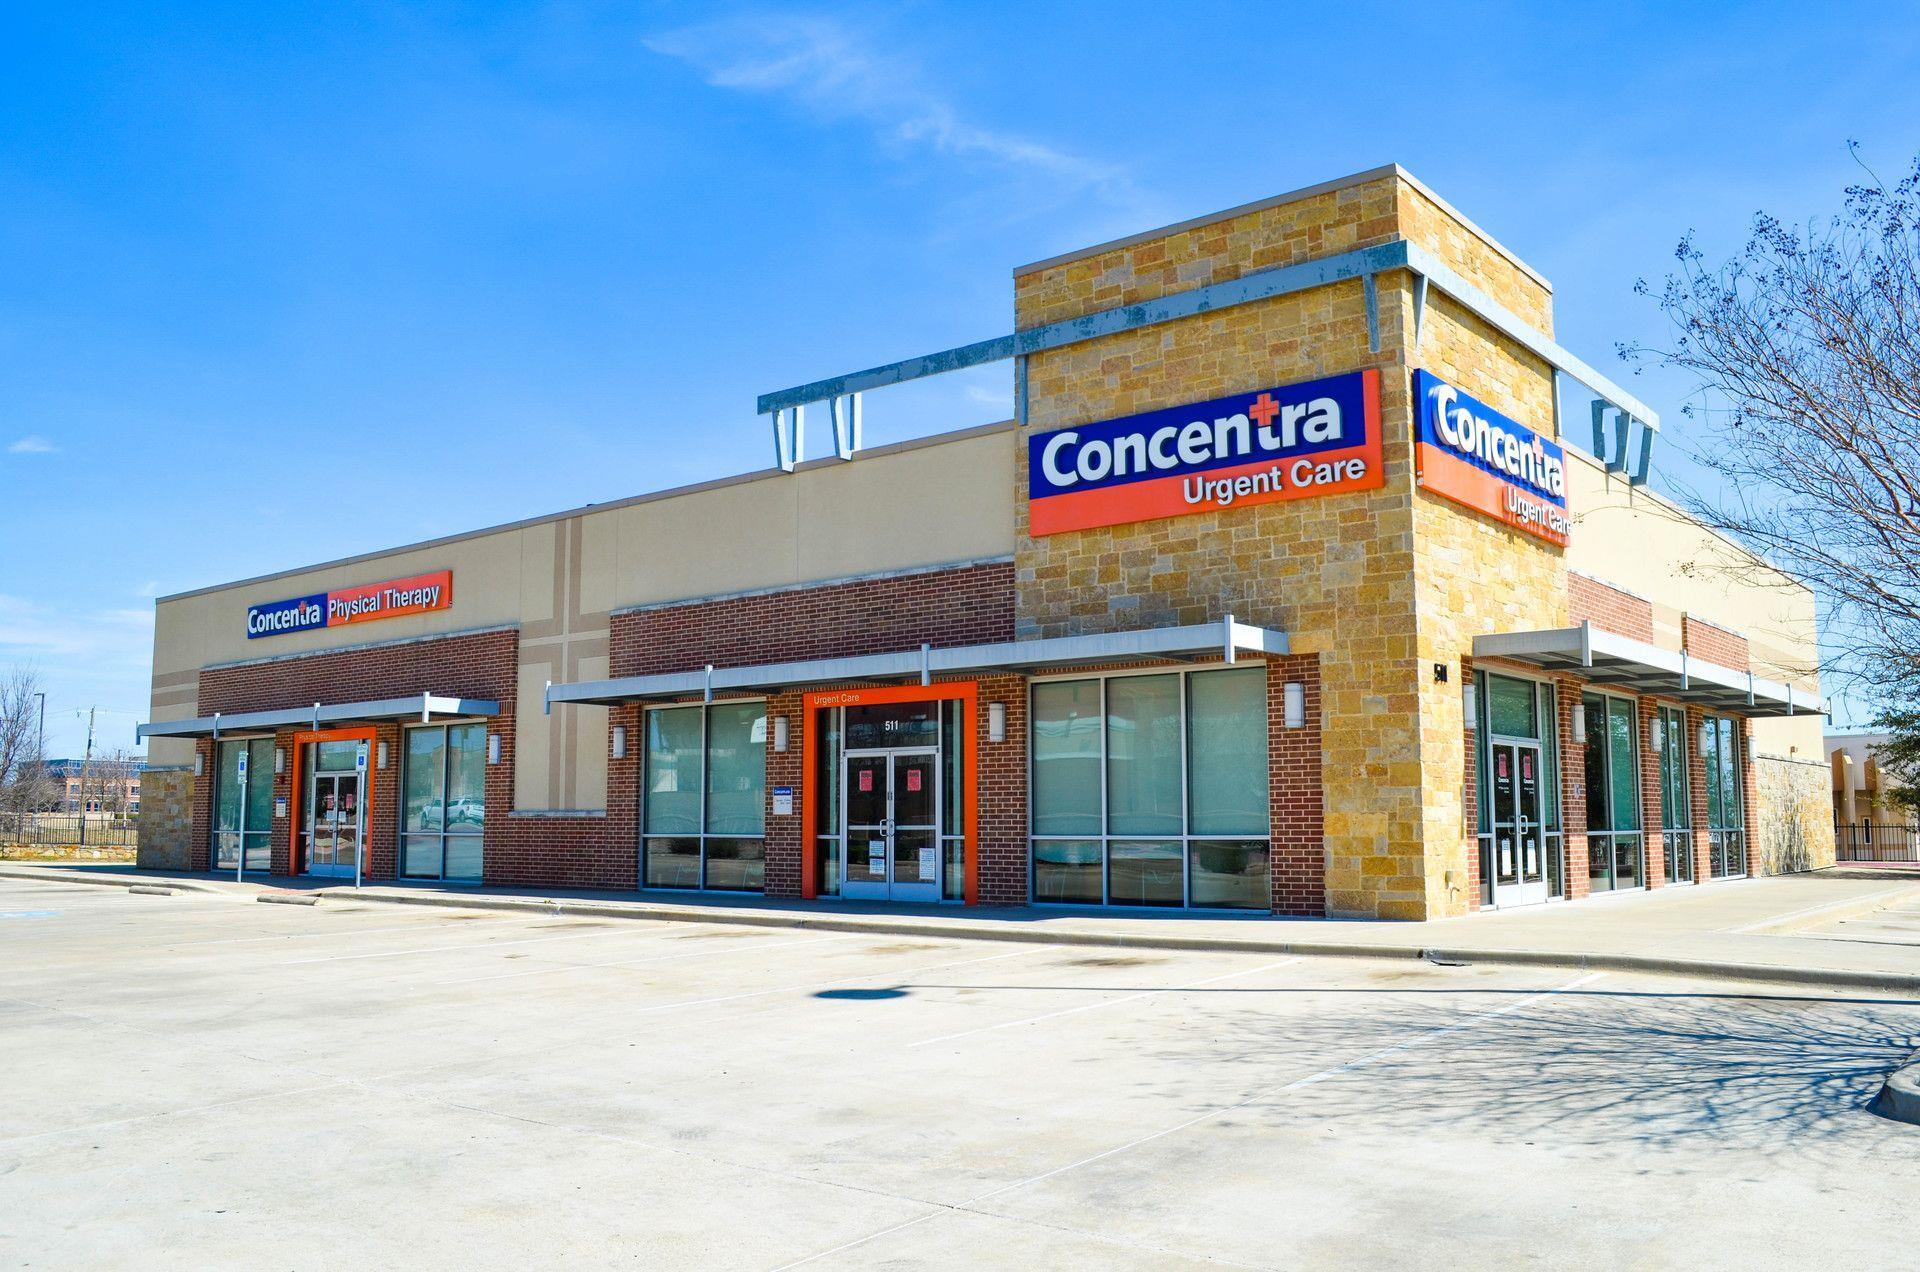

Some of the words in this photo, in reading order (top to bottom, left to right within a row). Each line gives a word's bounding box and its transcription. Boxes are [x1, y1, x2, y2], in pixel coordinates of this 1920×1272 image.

[1041, 392, 1344, 487] Concentra
[1428, 383, 1566, 499] Concentra
[1183, 465, 1283, 506] Urgent
[1290, 457, 1367, 489] Care
[1506, 485, 1547, 526] Urgent
[1547, 504, 1573, 536] Care
[247, 600, 323, 634] Concentra
[327, 591, 381, 622] Physical
[383, 585, 441, 611] Therapy
[813, 695, 840, 705] Urgent
[841, 693, 860, 703] Care
[885, 720, 899, 731] 511
